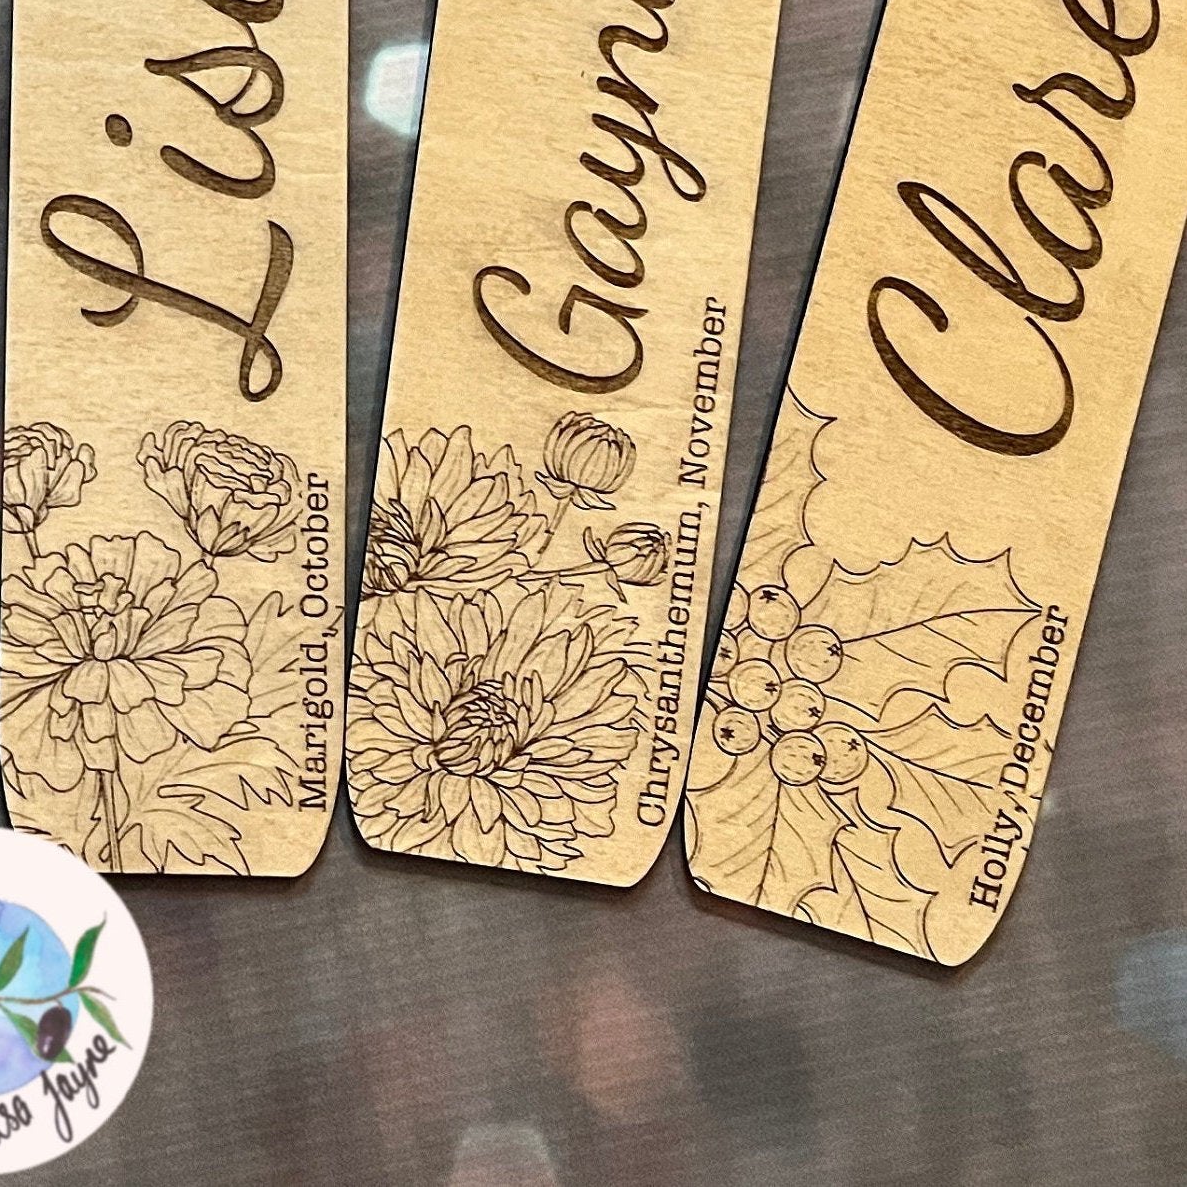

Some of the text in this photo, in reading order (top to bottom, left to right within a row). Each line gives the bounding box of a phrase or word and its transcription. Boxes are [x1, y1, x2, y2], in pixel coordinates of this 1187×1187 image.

[298, 471, 339, 813] Marigold, October
[637, 295, 728, 828] Chrysanthemum, November
[968, 605, 1070, 913] Holly, December
